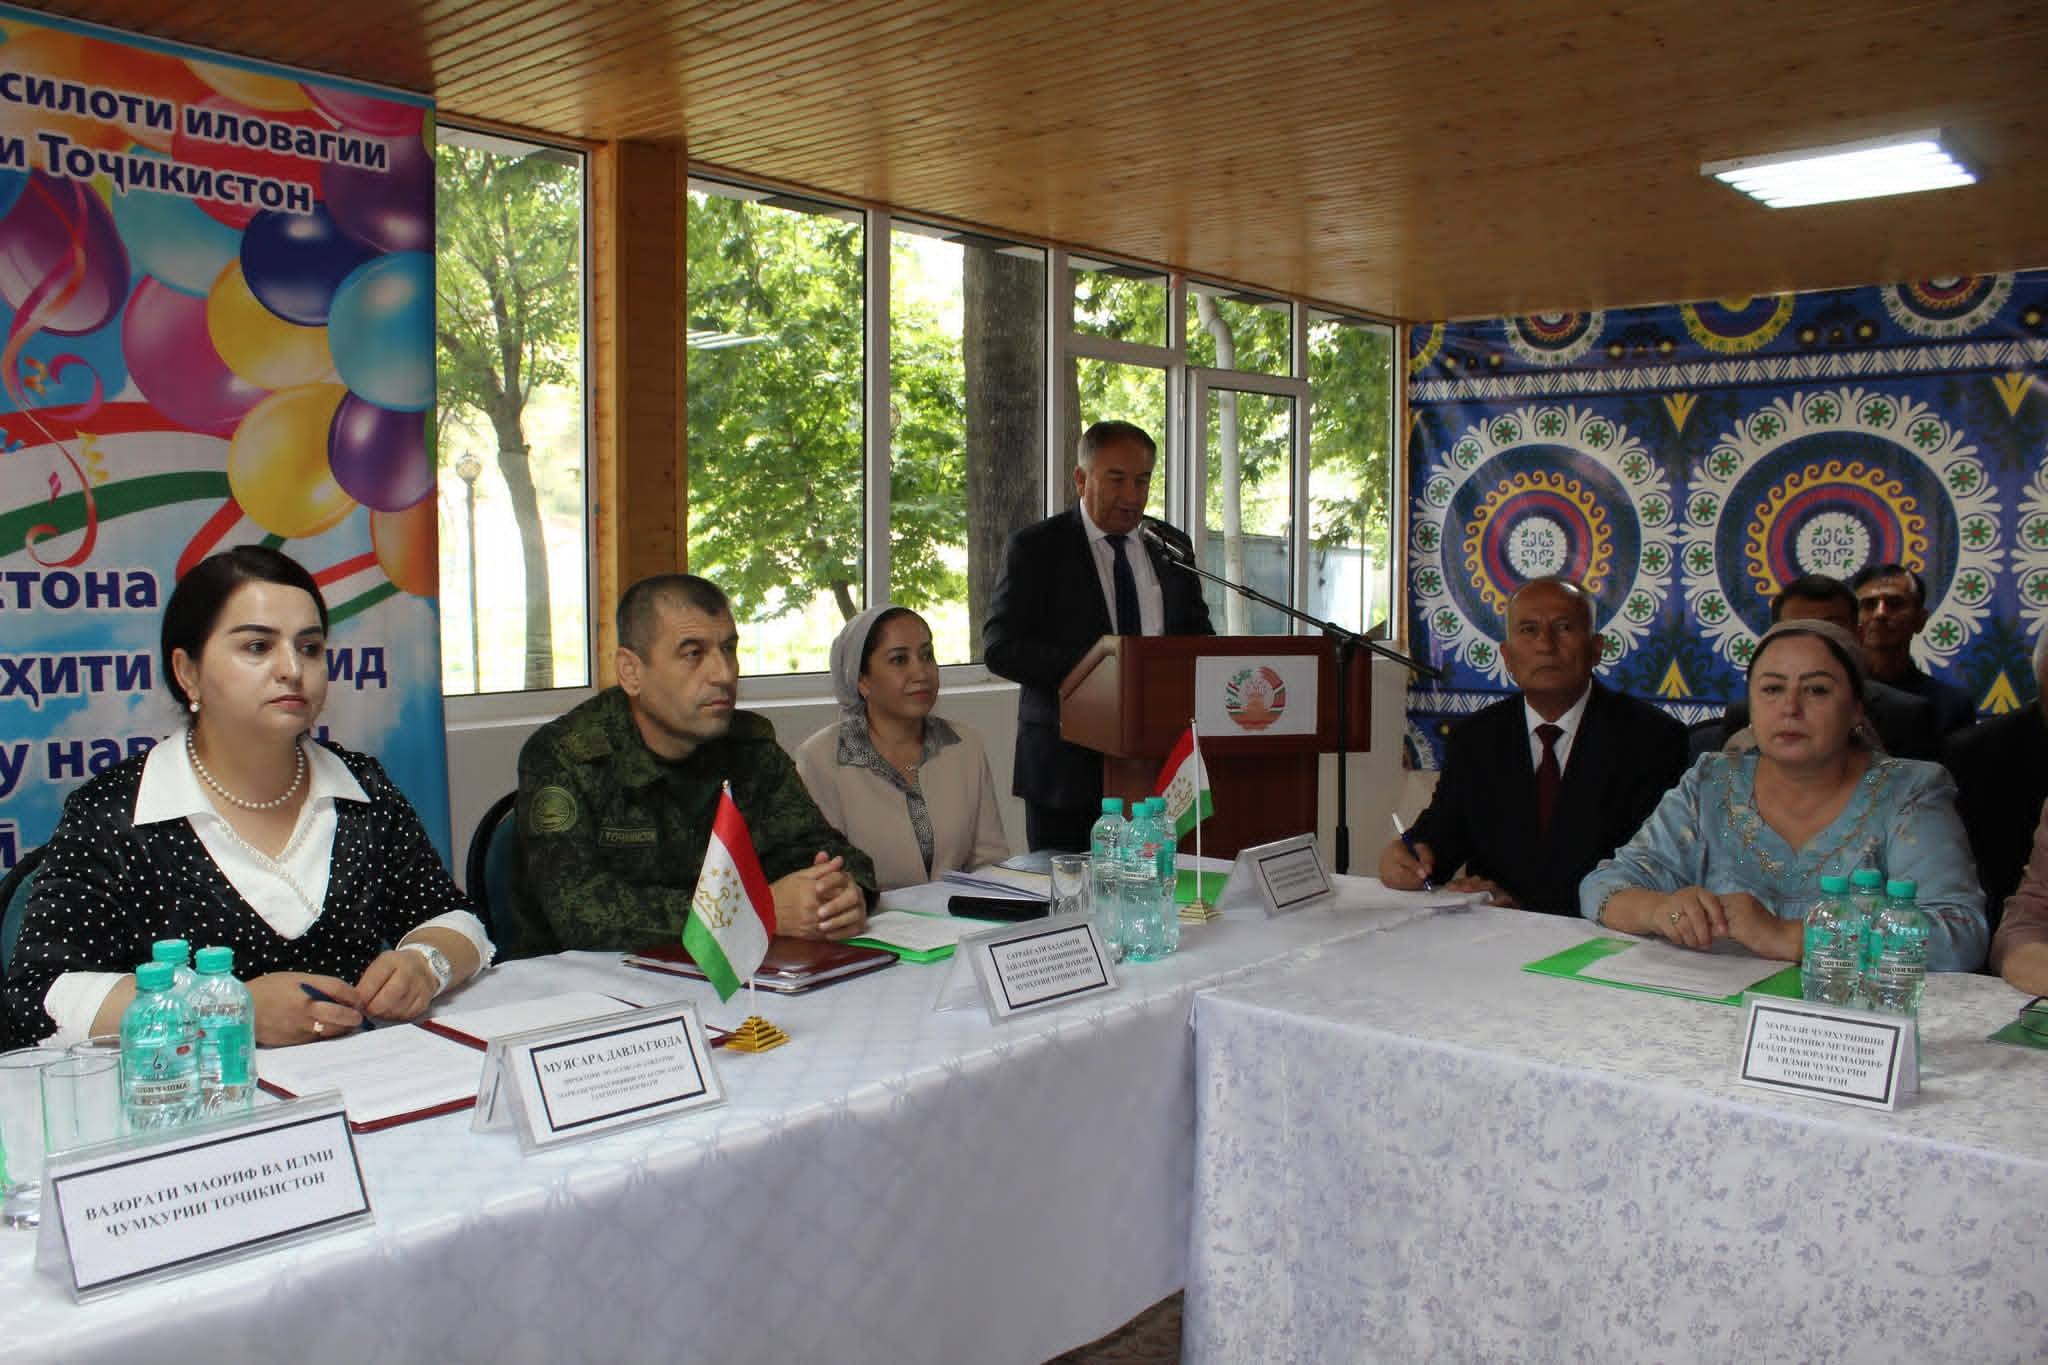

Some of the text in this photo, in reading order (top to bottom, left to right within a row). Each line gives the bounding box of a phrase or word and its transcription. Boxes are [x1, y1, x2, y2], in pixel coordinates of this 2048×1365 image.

[0, 72, 386, 169] силоти иловагии
[38, 133, 312, 212] Тоҷикистон
[543, 1052, 604, 1074] МУЯСАРА
[606, 1035, 683, 1062] ДАВЛАТЗОДА
[85, 1148, 335, 1221] ВАЗОРАТИ МАОРИФ ВА ИЛМИ
